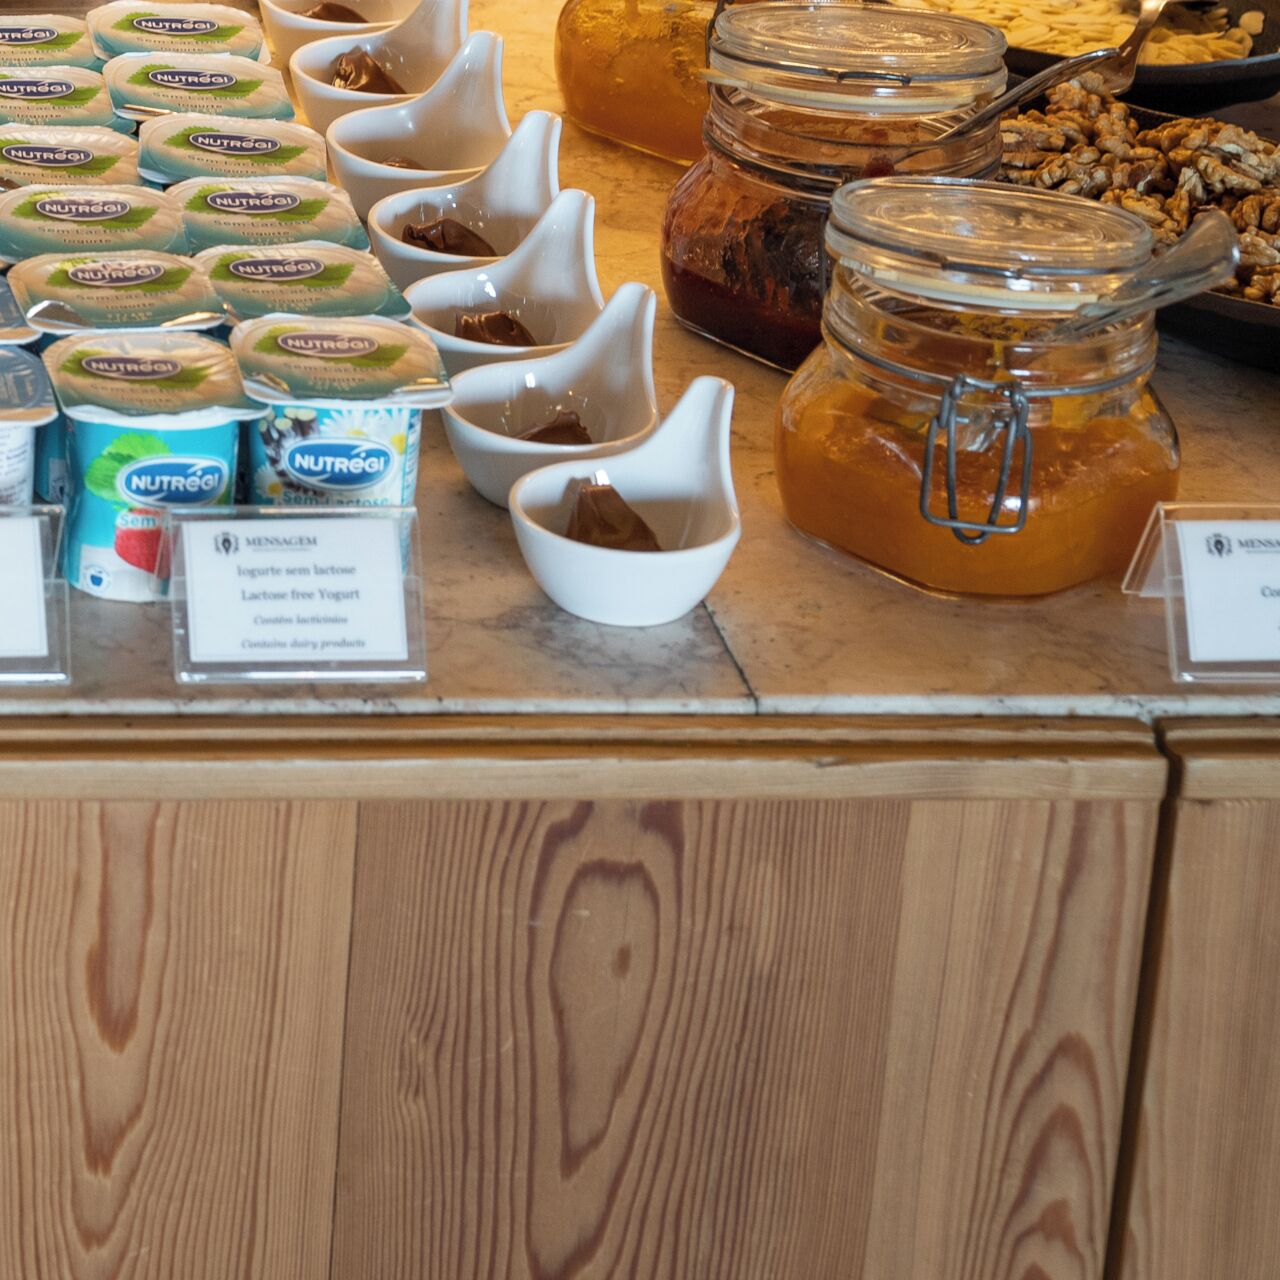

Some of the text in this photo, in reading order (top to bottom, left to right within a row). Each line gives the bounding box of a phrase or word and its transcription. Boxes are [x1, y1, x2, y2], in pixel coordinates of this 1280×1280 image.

[119, 514, 157, 527] Sem
[246, 536, 317, 547] MENSAGEM
[237, 564, 356, 578] Iogurte sem lactose
[241, 589, 360, 602] Lactose free Yogurt
[320, 638, 365, 649] products
